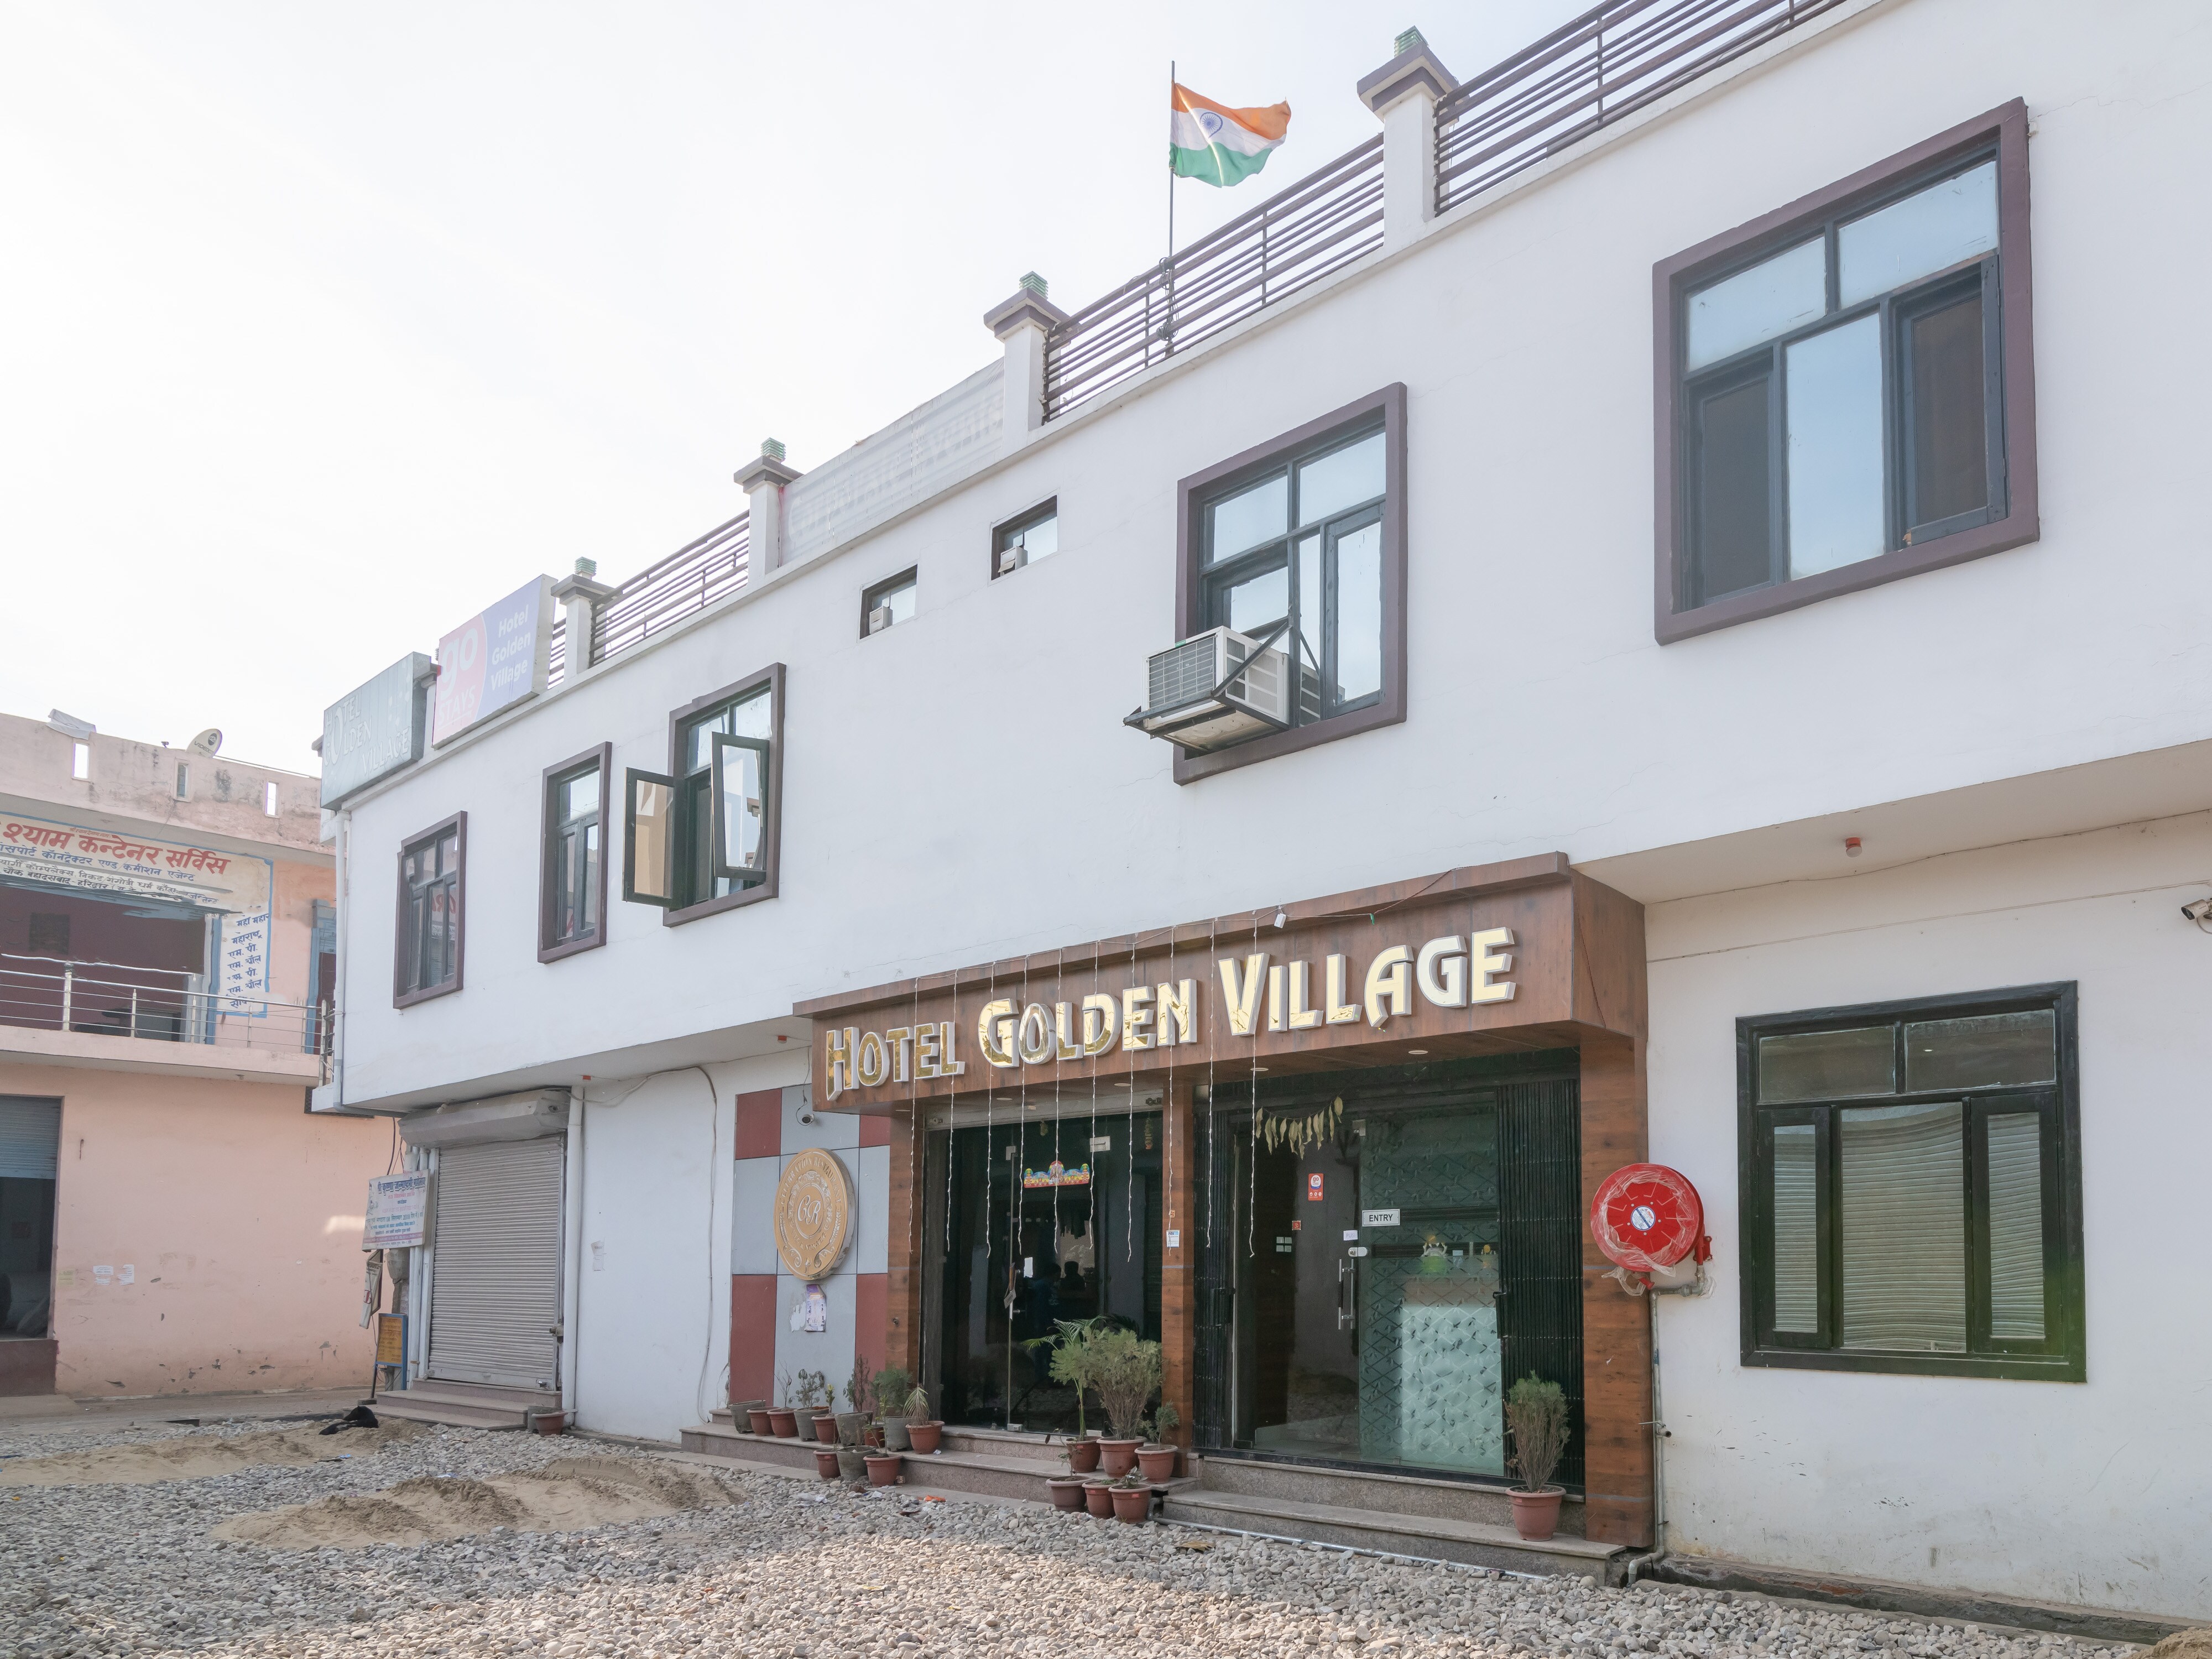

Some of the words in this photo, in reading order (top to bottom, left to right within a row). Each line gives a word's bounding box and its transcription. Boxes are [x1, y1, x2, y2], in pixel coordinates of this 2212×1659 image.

[498, 604, 529, 638] Hotel
[441, 628, 478, 701] go
[492, 632, 531, 665] Golden
[491, 659, 528, 691] Village
[439, 685, 476, 721] STAYS
[362, 726, 411, 777] VILLAGE
[0, 842, 37, 856] ांसपोर्ट
[98, 859, 119, 869] एण्ड
[123, 863, 162, 875] कमीशन
[3, 823, 75, 850] श्याम
[79, 834, 163, 865] कन्टेनर
[166, 848, 232, 875] सर्विस
[826, 1021, 966, 1101] HOTEL
[978, 978, 1197, 1068] GOLDEN
[1218, 927, 1516, 1036] VILLAGE
[797, 1194, 821, 1224] CR
